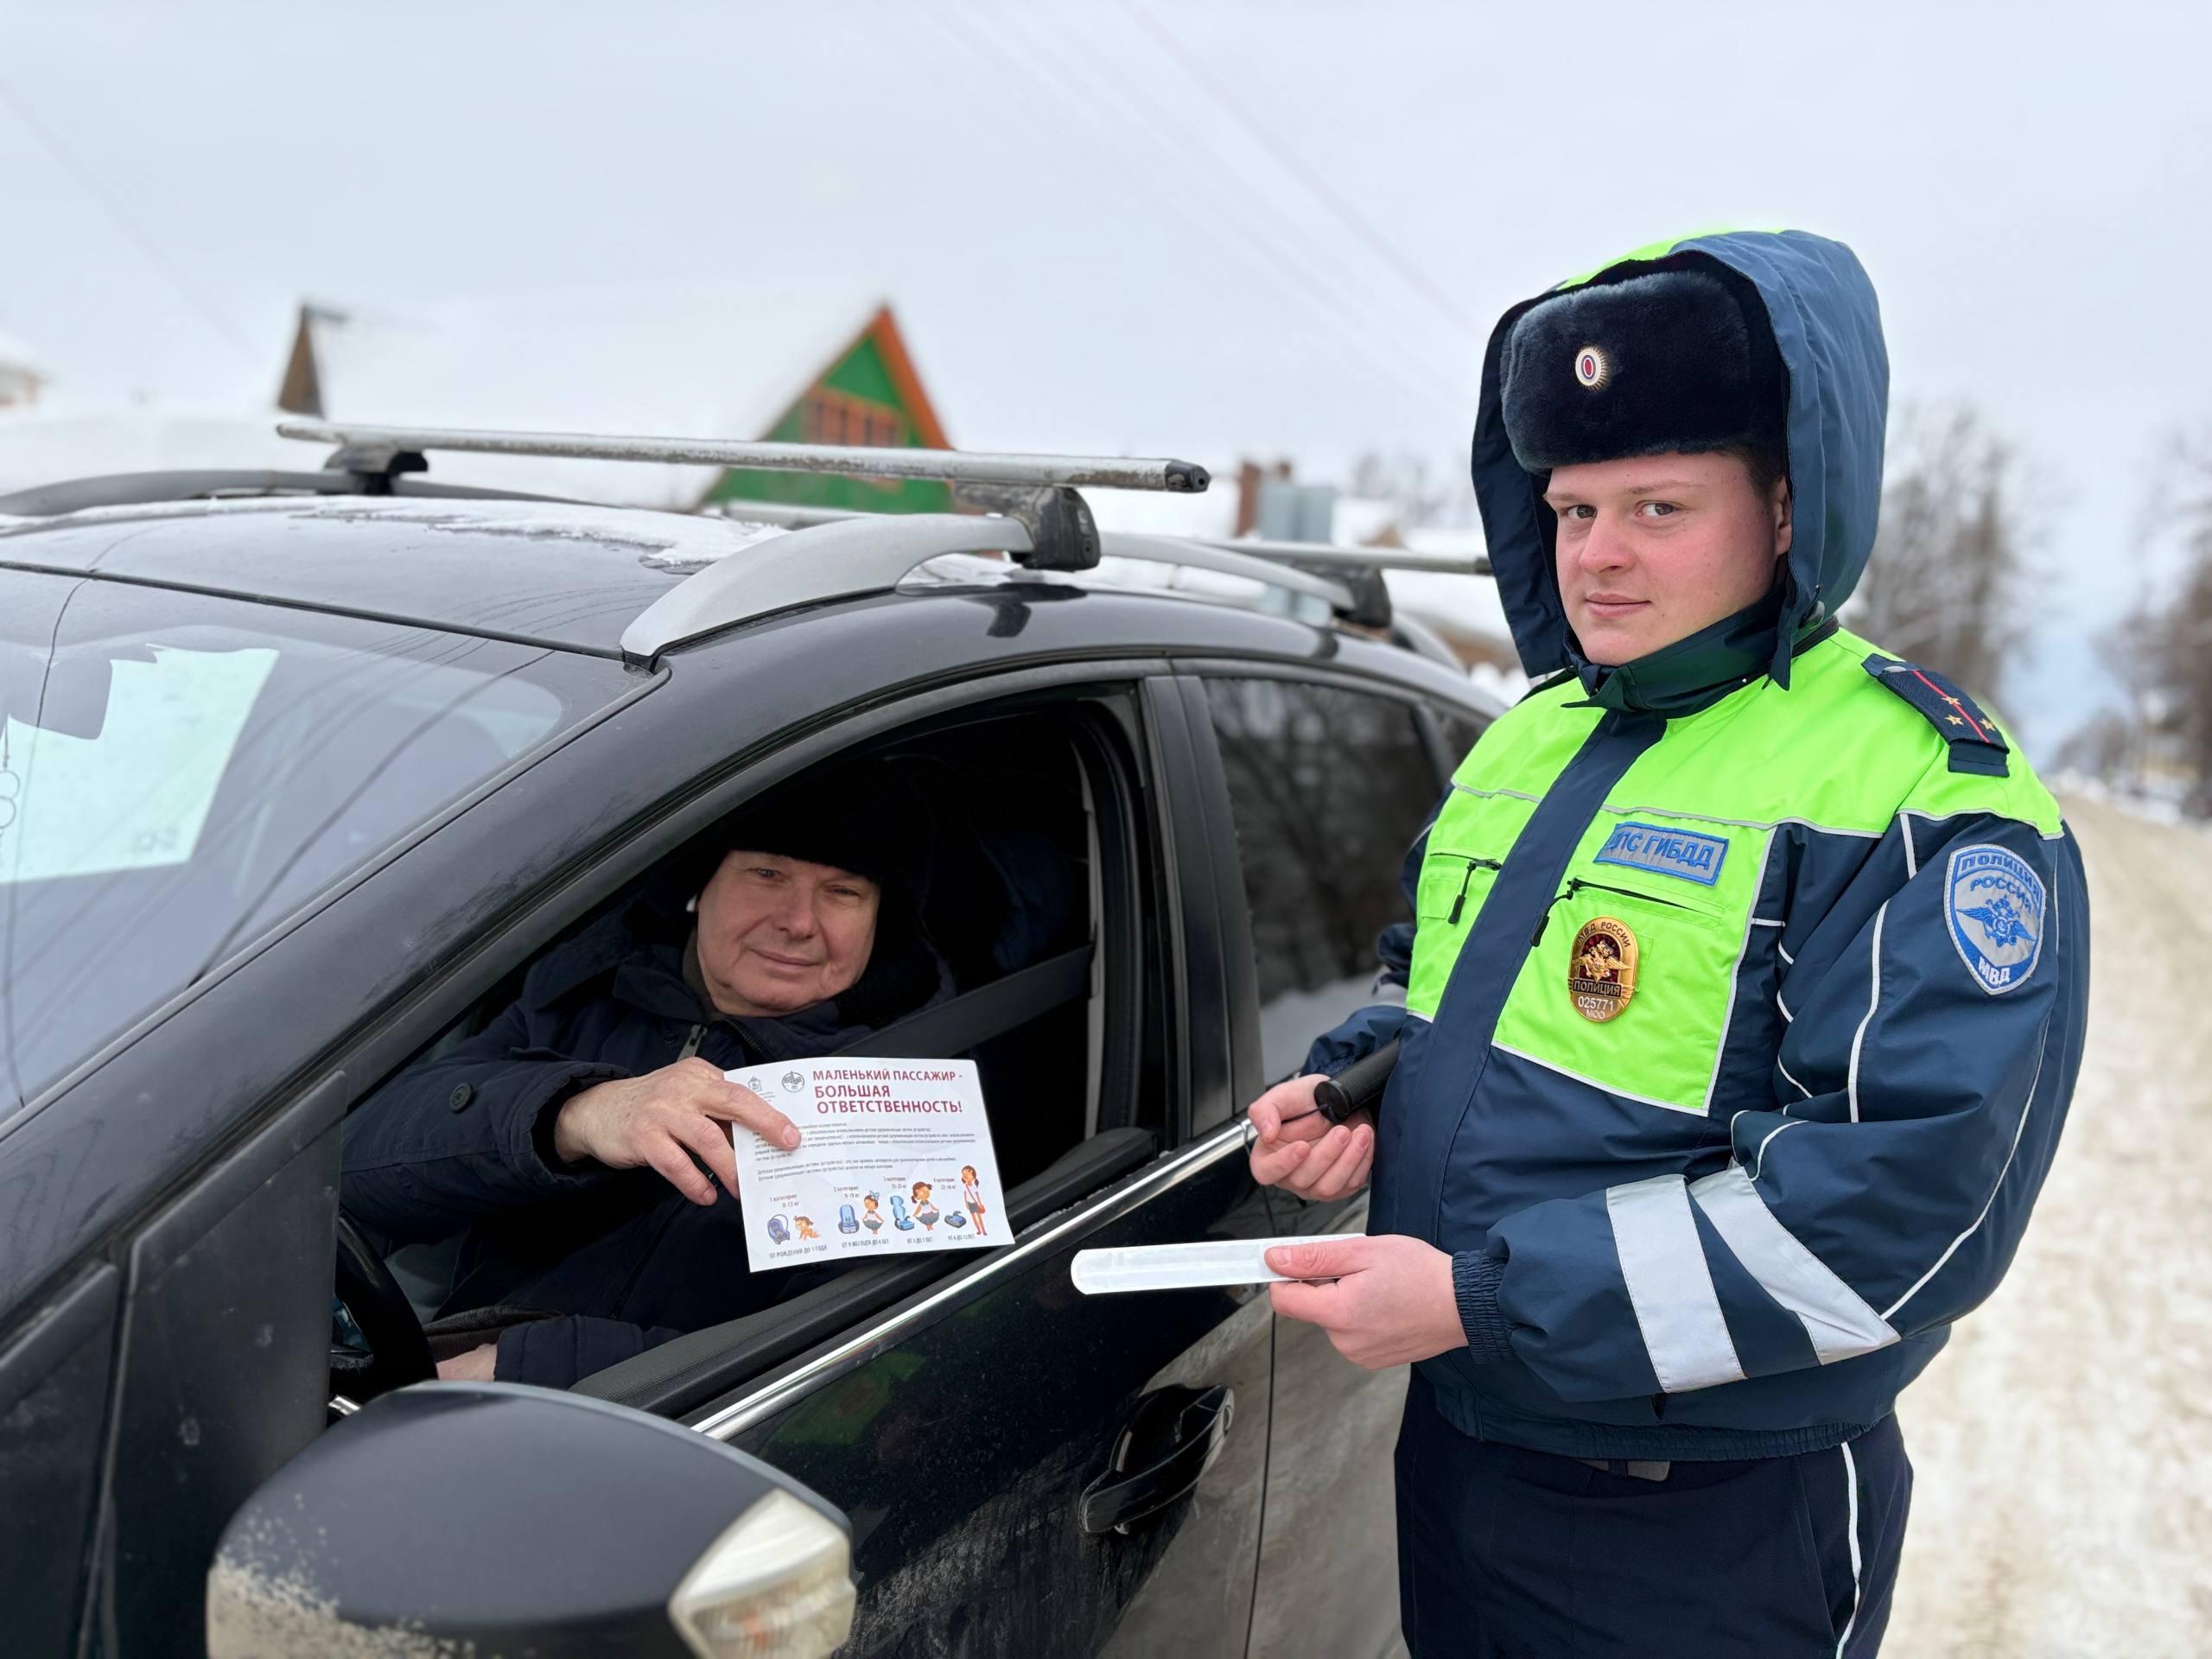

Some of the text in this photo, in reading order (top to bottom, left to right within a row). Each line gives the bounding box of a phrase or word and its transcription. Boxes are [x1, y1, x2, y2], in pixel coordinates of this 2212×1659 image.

[1643, 836, 1715, 871] ГИБДД
[1961, 854, 2041, 899] ПОЛИЦИЯ
[1578, 921, 1631, 948] МВД РОССИИ
[1978, 956, 2011, 986] МВД
[1573, 980, 1621, 997] ПОЛИЦИЯ
[1578, 995, 1614, 1012] 025771
[1586, 1008, 1605, 1020] МОО
[813, 1068, 891, 1081] МАЛЕНЬКИЙ
[893, 1071, 956, 1081] ПАССАЖИР
[815, 1085, 891, 1098] БОЛЬШАЯ
[817, 1100, 963, 1114] ОТВЕТСТВЕННОСТЬ!
